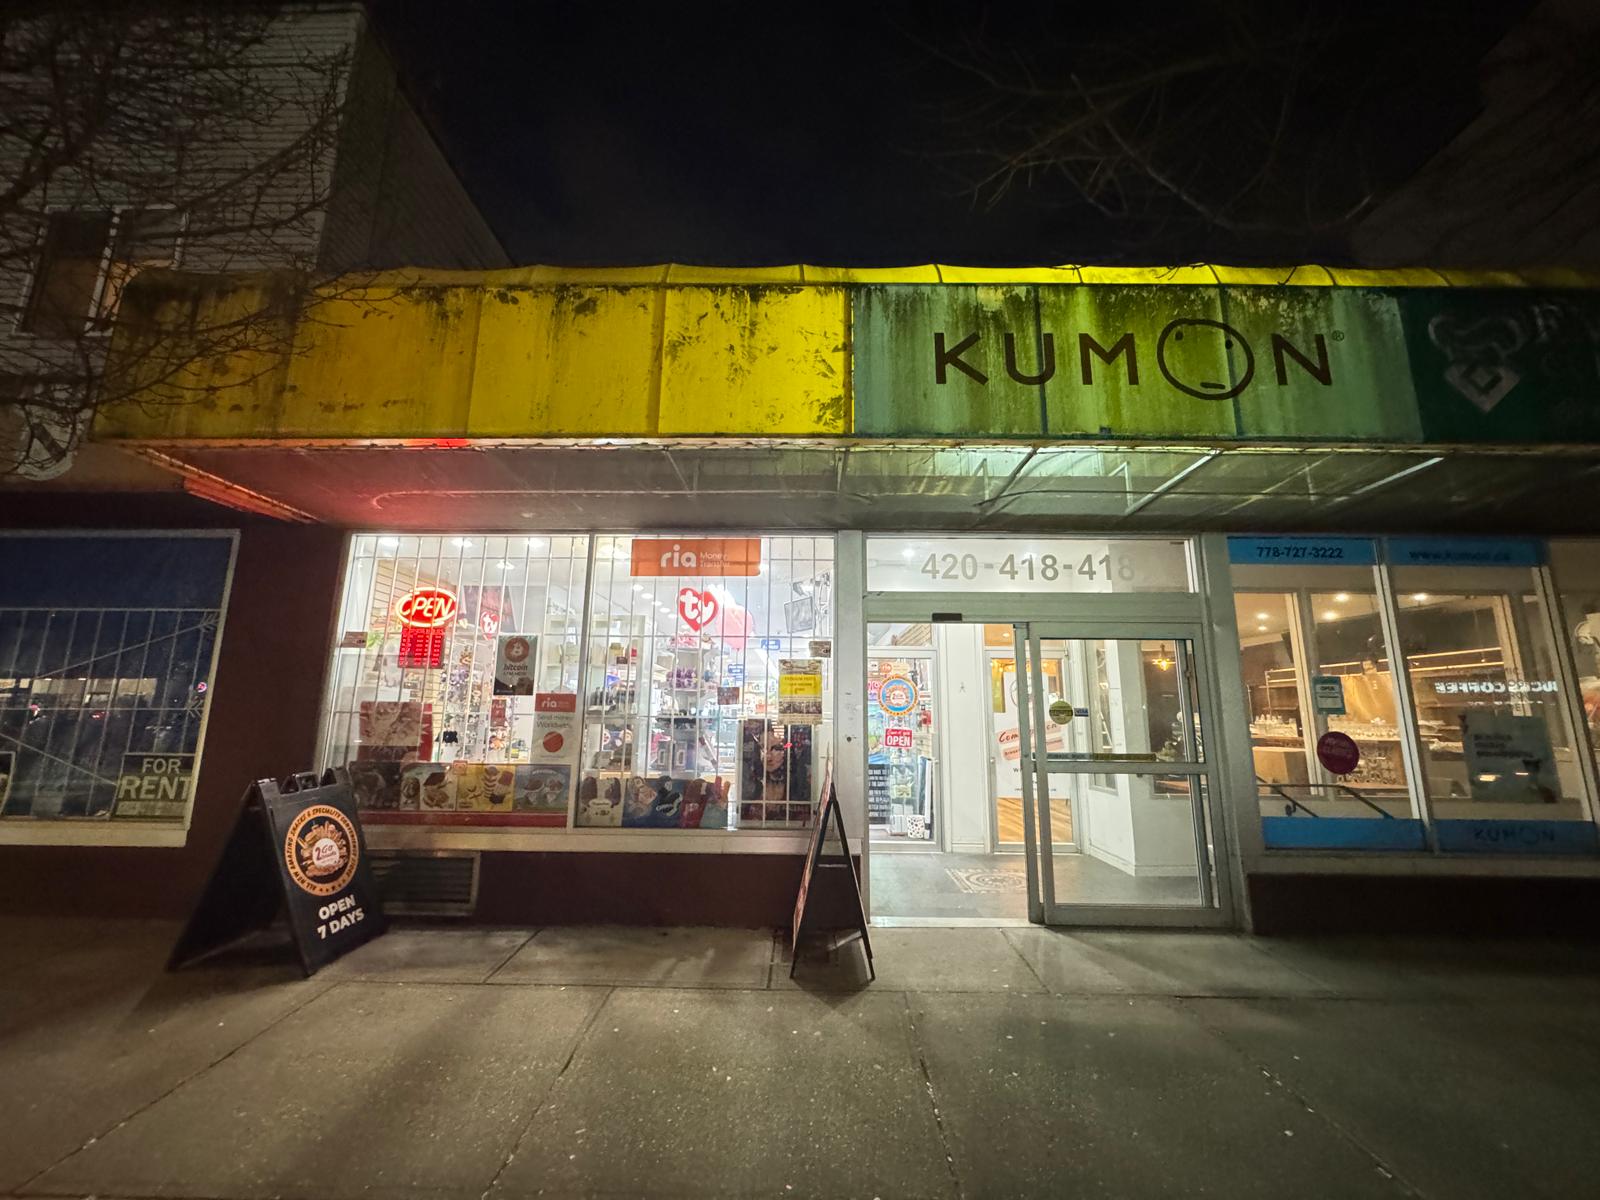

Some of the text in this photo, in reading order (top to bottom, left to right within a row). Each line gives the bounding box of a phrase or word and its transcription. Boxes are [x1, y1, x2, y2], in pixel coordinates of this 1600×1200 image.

[934, 318, 1333, 401] KUMON
[660, 543, 697, 568] ria
[1256, 546, 1344, 559] 778-727-3222
[921, 552, 1136, 582] 420-418-418
[503, 663, 528, 672] bitcoin
[541, 697, 557, 708] ria
[887, 735, 910, 747] OPEN
[141, 757, 182, 775] FOR
[118, 775, 192, 801] RENT
[318, 894, 356, 920] OPEN
[317, 908, 365, 940] 7 DAYS
